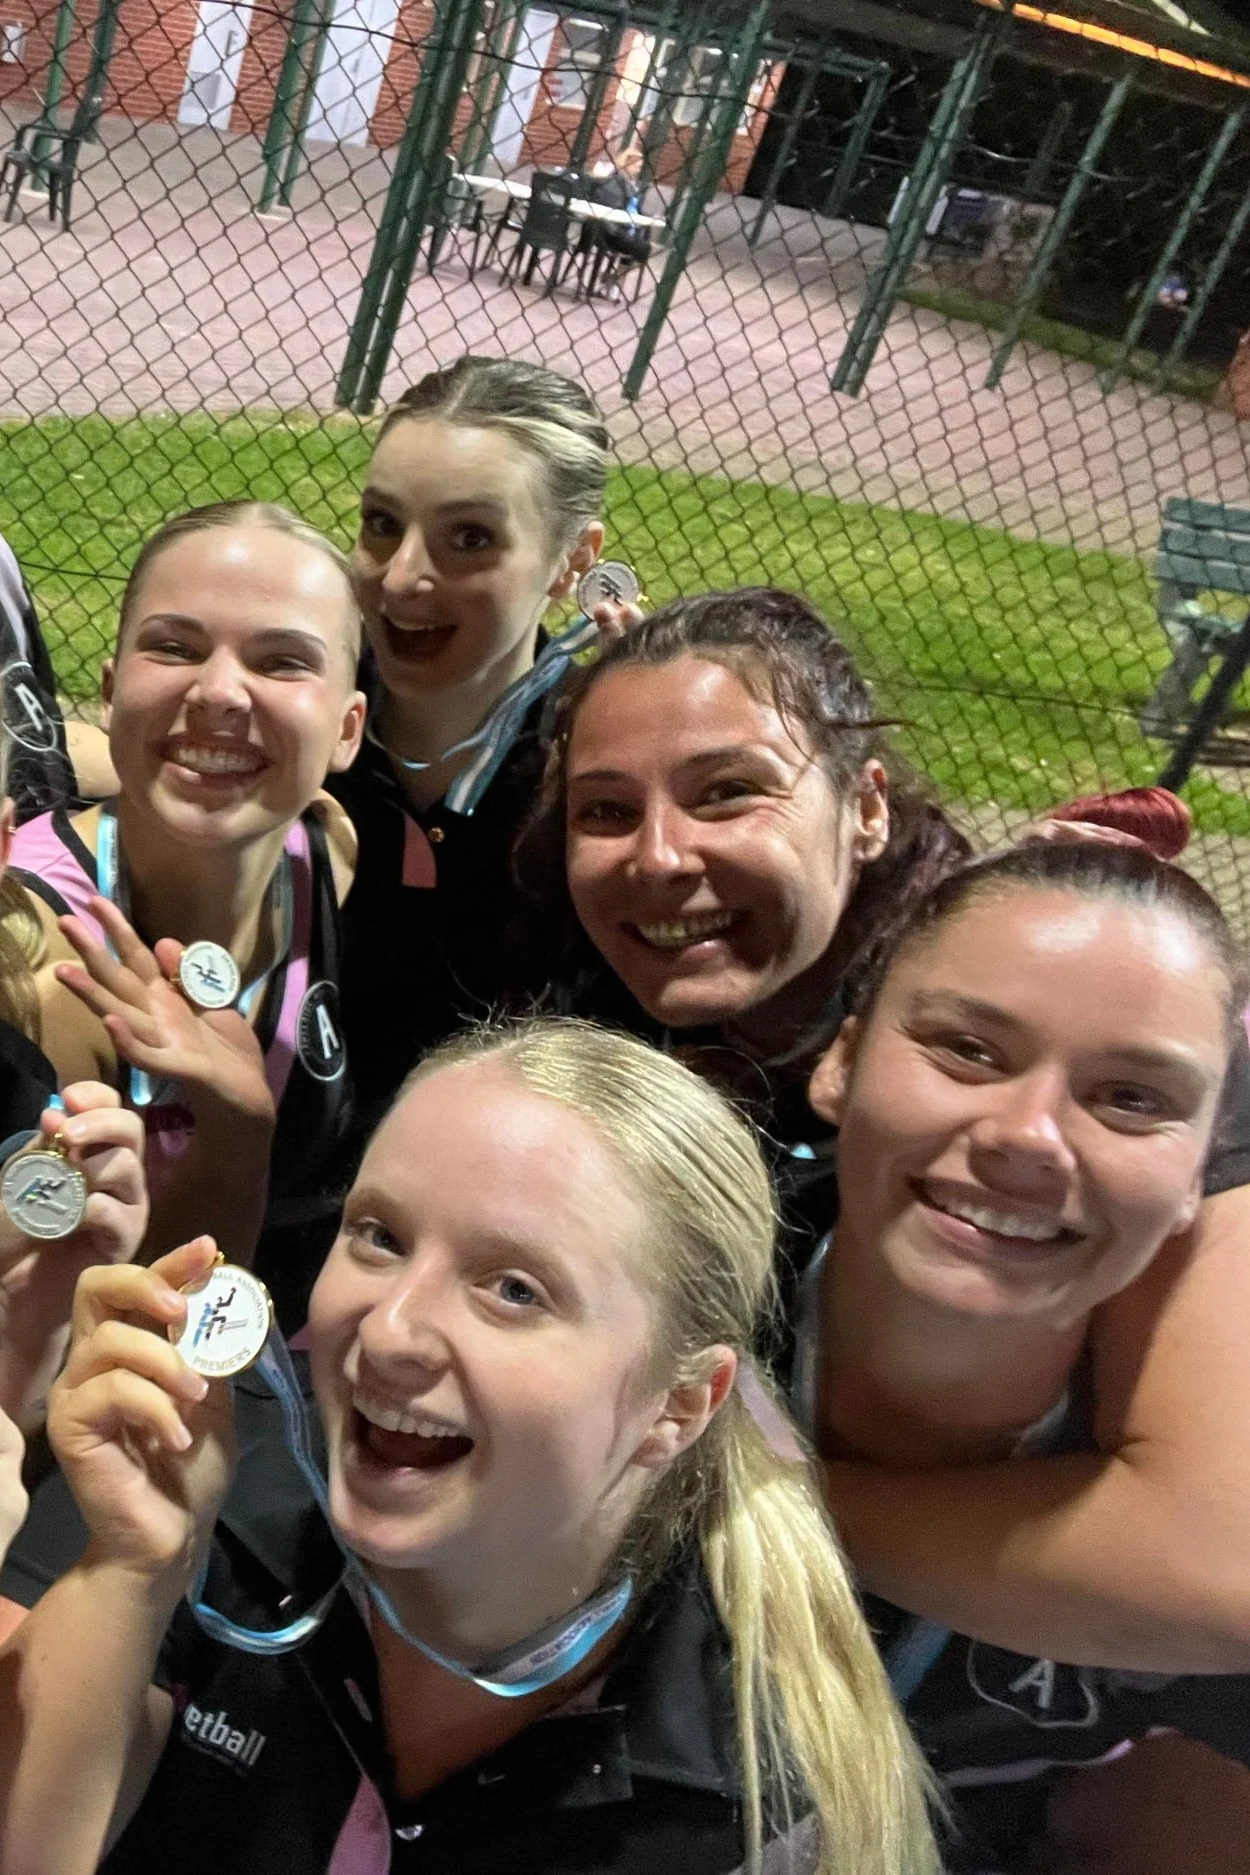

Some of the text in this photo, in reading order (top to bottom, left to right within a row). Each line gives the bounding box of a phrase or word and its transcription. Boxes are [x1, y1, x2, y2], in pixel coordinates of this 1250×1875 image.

[14, 683, 44, 732] A
[316, 1003, 340, 1060] A
[1008, 1658, 1055, 1709] A
